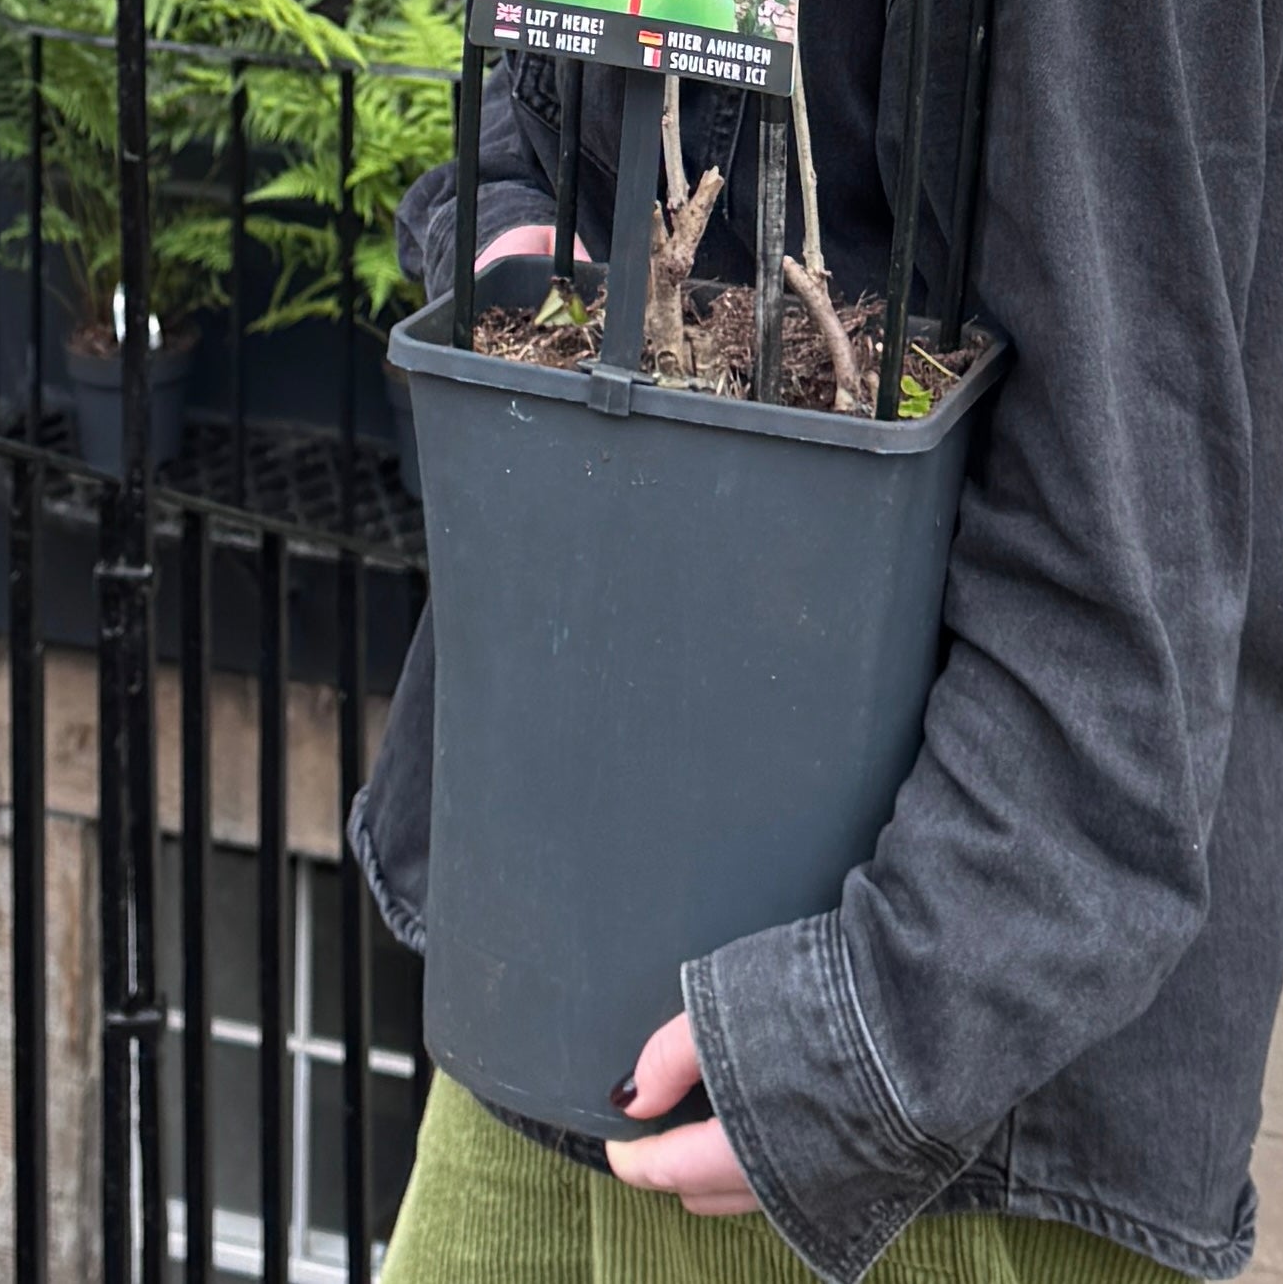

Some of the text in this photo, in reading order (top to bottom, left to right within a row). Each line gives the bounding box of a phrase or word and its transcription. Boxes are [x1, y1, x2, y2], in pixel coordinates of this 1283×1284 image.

[525, 8, 605, 35] LIFT HERE!
[527, 28, 597, 55] TIL HIER!
[667, 31, 772, 66] HIER ANHEBEN
[669, 51, 767, 86] SOULEVER ICI
